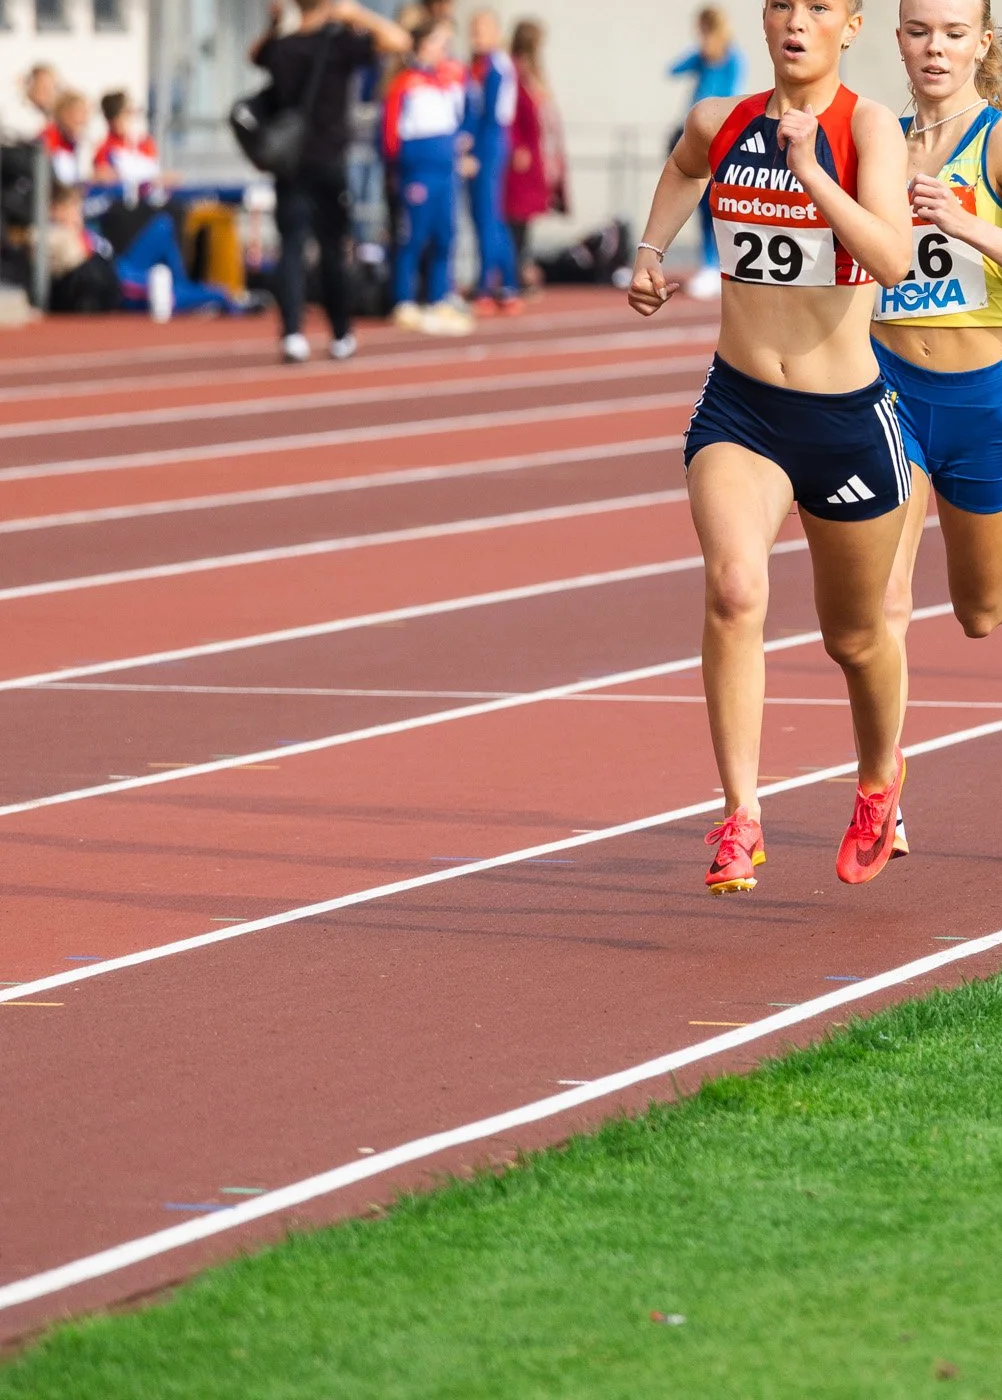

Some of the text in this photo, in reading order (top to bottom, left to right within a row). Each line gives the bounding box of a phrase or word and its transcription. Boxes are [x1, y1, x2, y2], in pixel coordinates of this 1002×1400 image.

[723, 164, 804, 192] NORWA
[718, 197, 817, 220] motonet
[733, 232, 804, 282] 29
[903, 233, 953, 281] 6
[881, 279, 966, 313] HOKA
